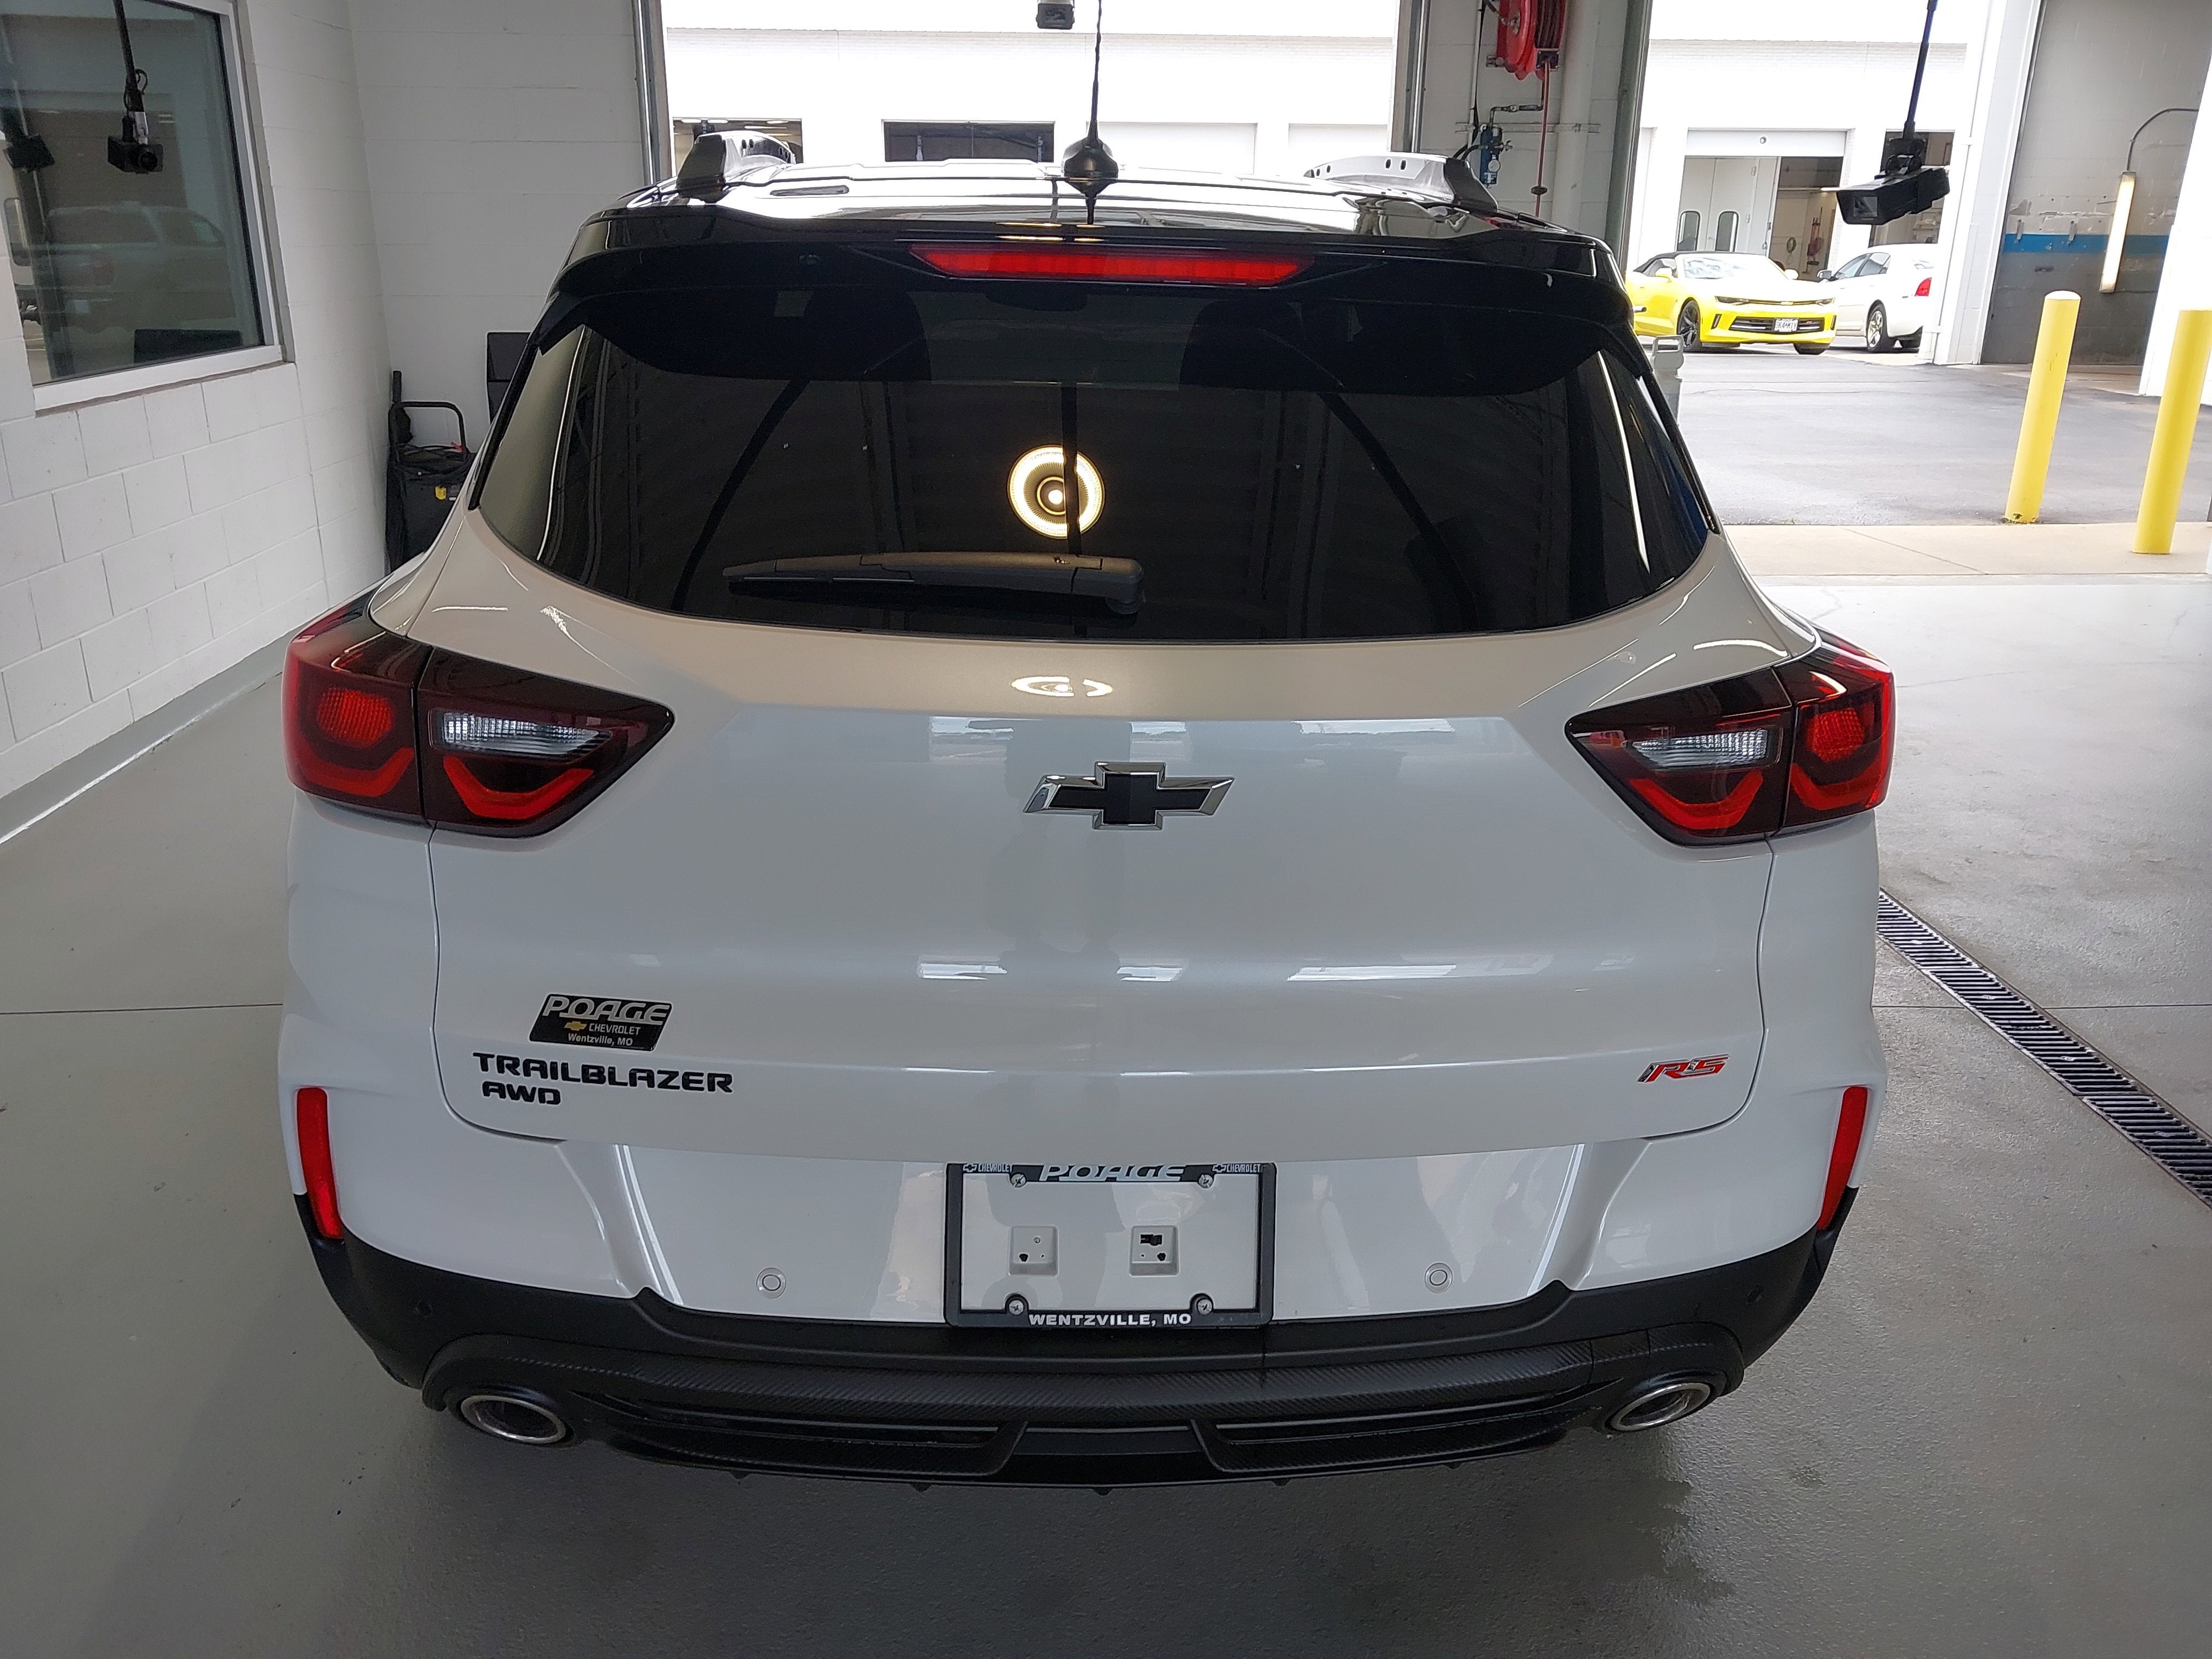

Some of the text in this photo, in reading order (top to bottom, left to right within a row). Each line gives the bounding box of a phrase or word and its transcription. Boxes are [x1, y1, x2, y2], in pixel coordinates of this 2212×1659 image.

[542, 995, 670, 1025] POAGE
[589, 1023, 641, 1036] CHEVROLET
[568, 1032, 633, 1046] Wentzville, MO
[473, 1052, 733, 1093] TRAILBLAZER
[1637, 1053, 1730, 1083] RS
[481, 1081, 561, 1105] AWD
[978, 1163, 1012, 1173] CHEVROLET
[1039, 1165, 1185, 1181] POAGE
[1226, 1163, 1262, 1173] CHEVROLET
[1028, 1313, 1192, 1327] WENTZVILLE, MO
